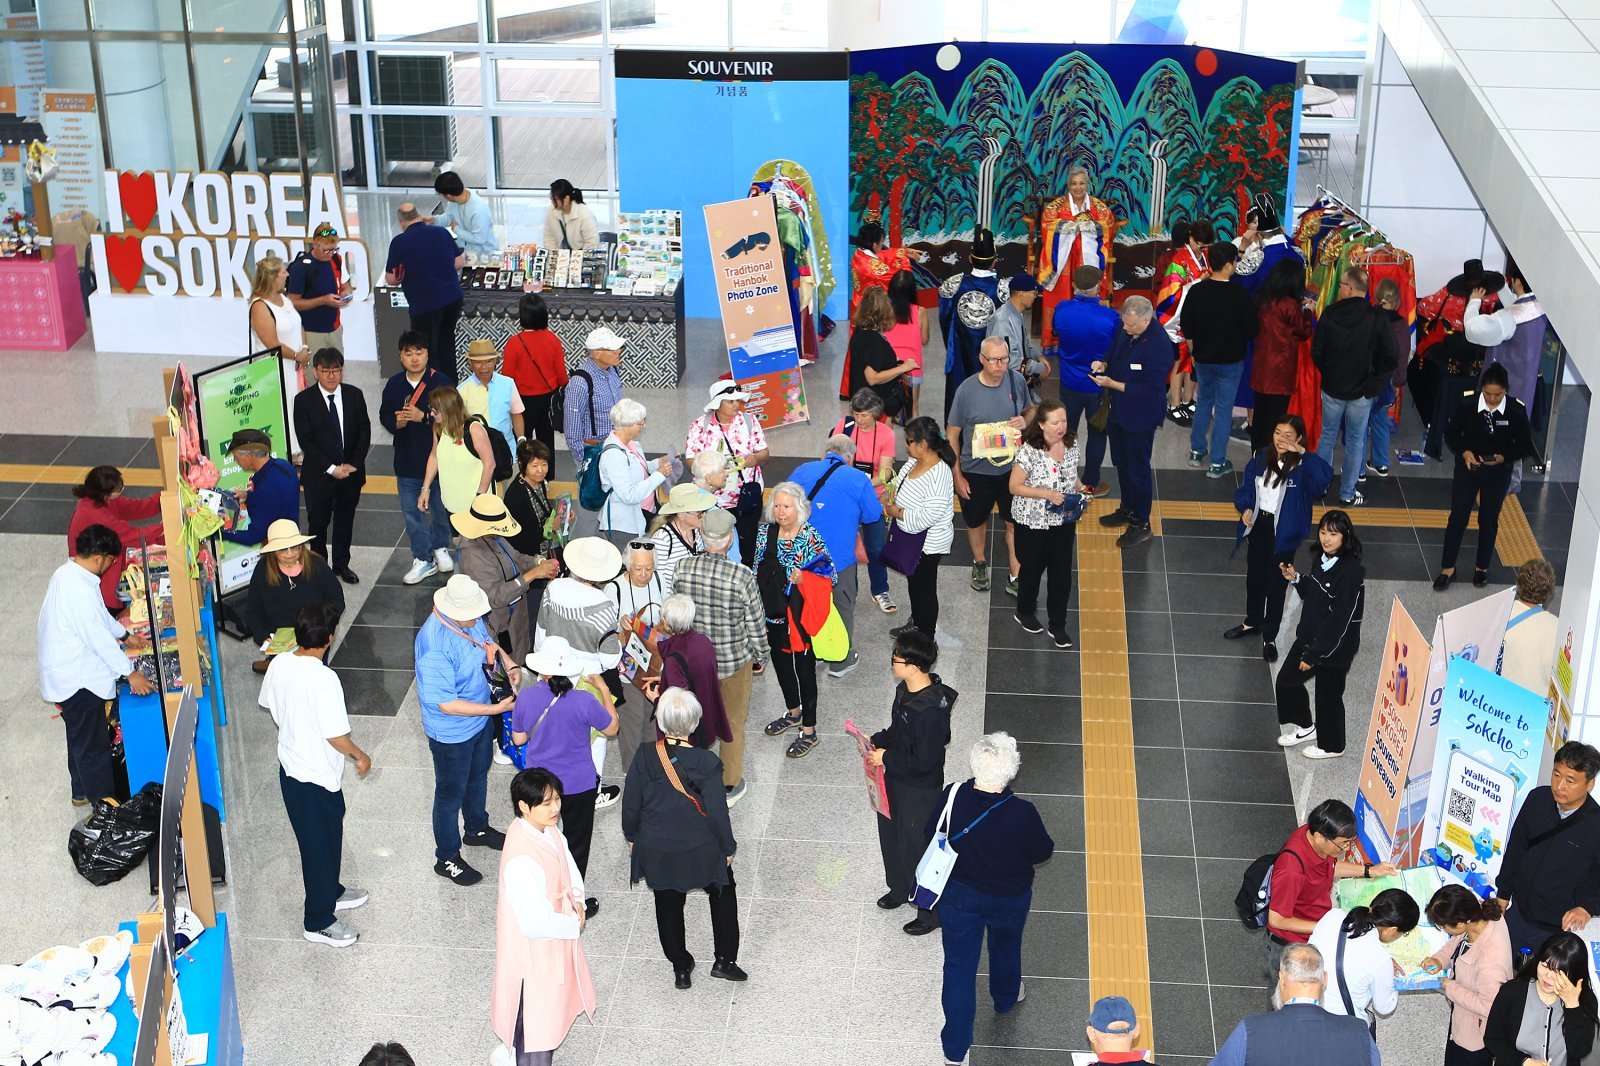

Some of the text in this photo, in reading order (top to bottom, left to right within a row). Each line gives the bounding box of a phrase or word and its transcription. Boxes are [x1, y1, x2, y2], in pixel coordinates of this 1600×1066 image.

[688, 60, 773, 76] SOUVENIR
[715, 86, 748, 97] 기념품
[104, 171, 347, 239] I KOREA
[91, 233, 371, 302] I SOKO
[724, 259, 774, 277] Traditional
[733, 274, 768, 288] Hanbok
[727, 285, 778, 301] Photo Zone
[225, 390, 260, 408] SHOPPING
[233, 403, 253, 416] FESTA
[1388, 703, 1408, 743] SOKCHO
[1459, 688, 1512, 723] Welcome
[1517, 714, 1529, 731] to
[1384, 720, 1404, 760] KOREA
[1466, 713, 1514, 752] Sokcho
[1375, 729, 1400, 776] Souvenir
[1370, 747, 1397, 799] Giveaway
[1464, 766, 1501, 792] Walking
[1460, 774, 1502, 802] Tour Map
